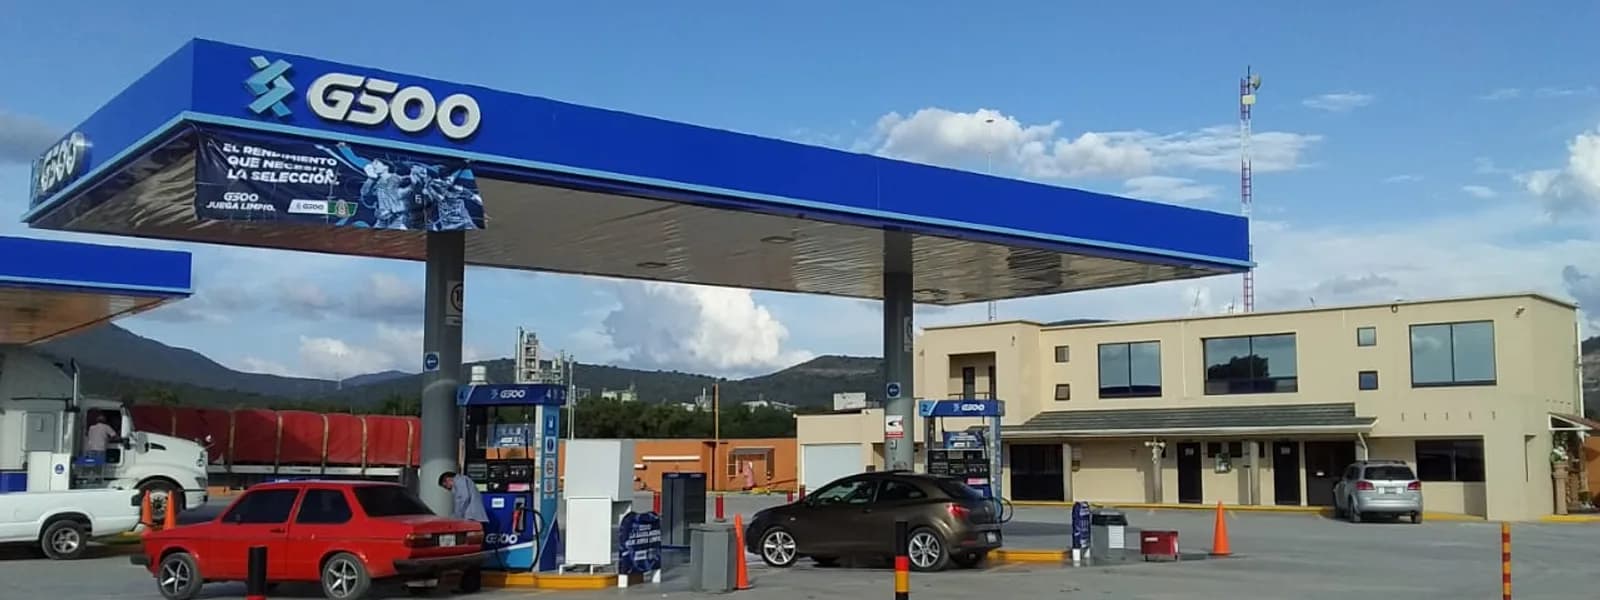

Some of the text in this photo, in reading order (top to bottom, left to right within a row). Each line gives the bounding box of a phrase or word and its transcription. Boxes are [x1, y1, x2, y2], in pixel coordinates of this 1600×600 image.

[307, 72, 481, 139] G500
[223, 142, 337, 166] EL RENDIMIENTO
[41, 131, 77, 193] G500
[227, 155, 261, 169] QUE
[226, 169, 248, 180] LA
[224, 192, 259, 201] G500
[206, 202, 239, 210] JUEGA
[500, 389, 526, 399] G500
